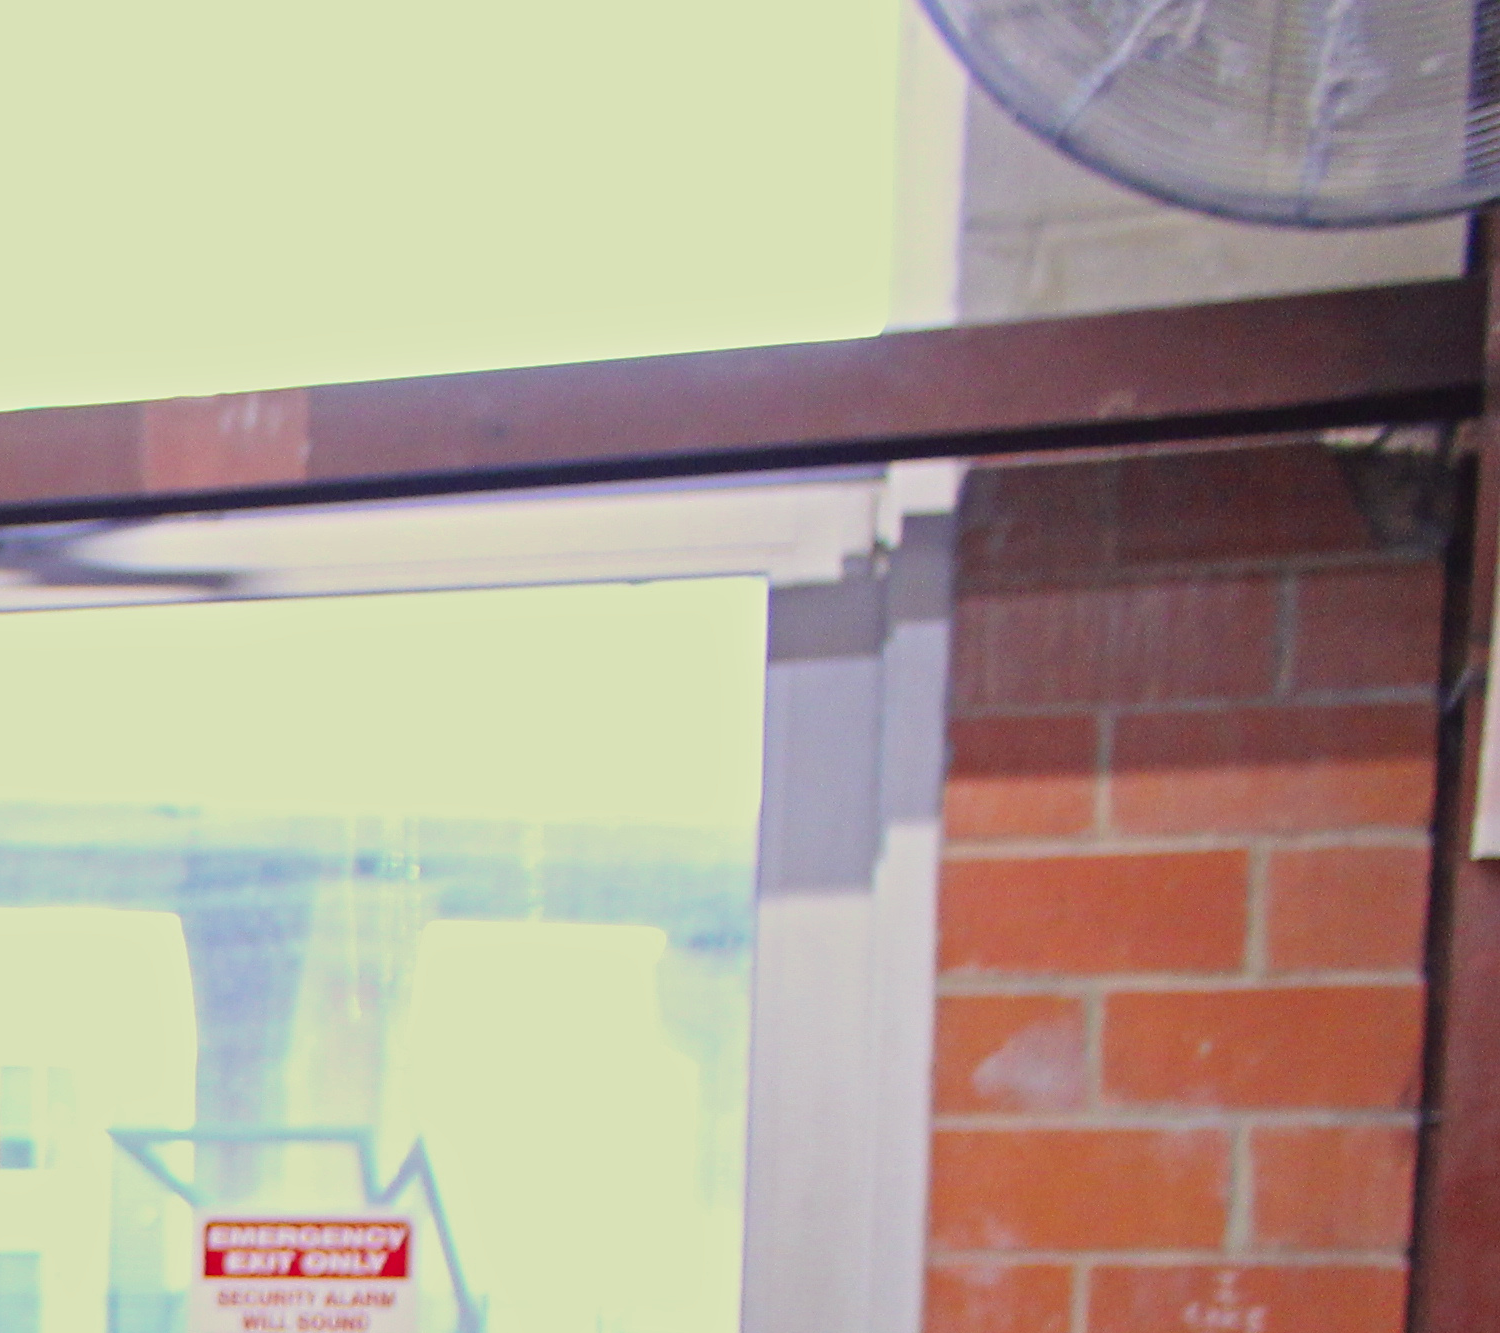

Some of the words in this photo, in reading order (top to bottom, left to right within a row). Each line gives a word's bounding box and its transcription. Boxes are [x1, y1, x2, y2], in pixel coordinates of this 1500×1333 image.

[208, 1225, 408, 1251] EMERGENCY
[222, 1250, 296, 1274] EXIT
[299, 1251, 389, 1275] ONLY
[217, 1289, 317, 1307] SECURITY
[324, 1290, 396, 1307] ALARM
[241, 1314, 286, 1331] WILL
